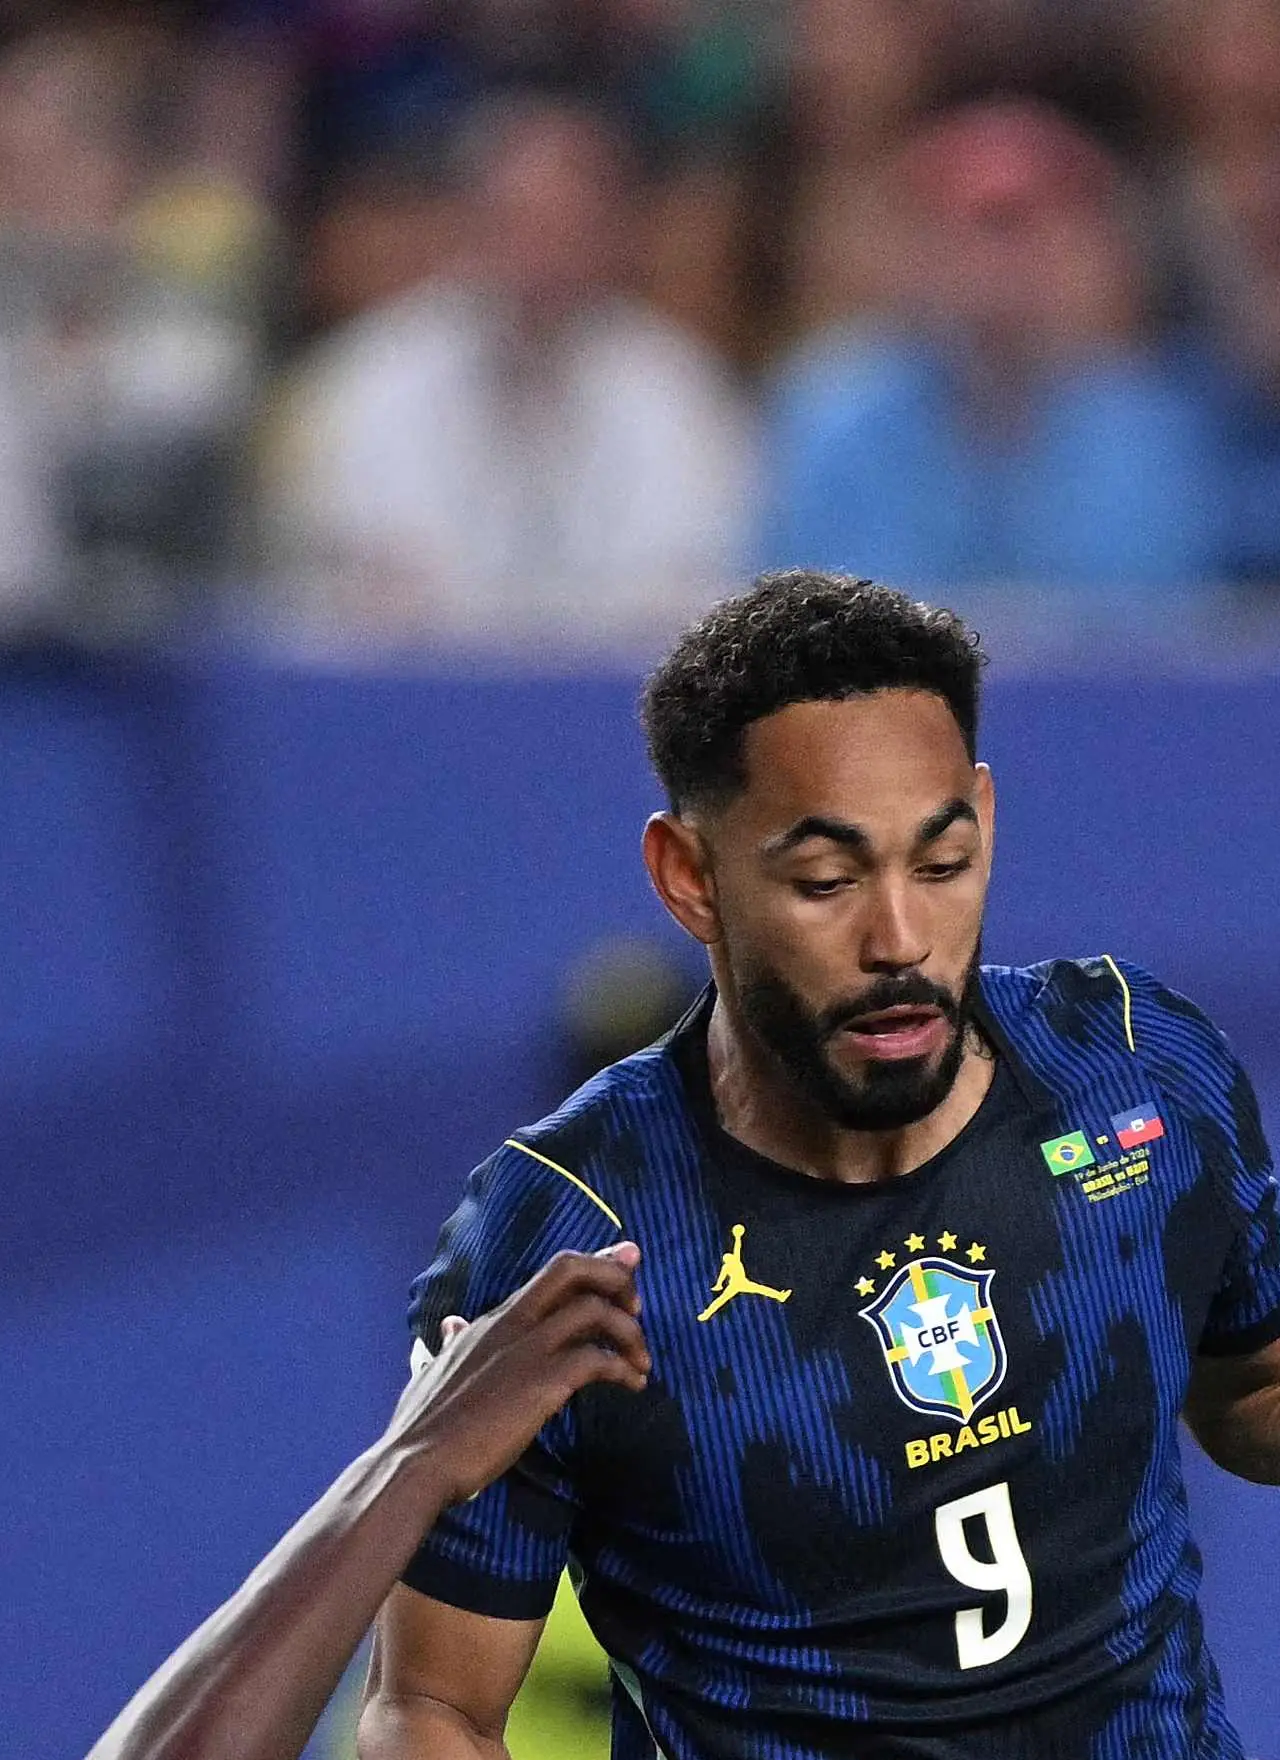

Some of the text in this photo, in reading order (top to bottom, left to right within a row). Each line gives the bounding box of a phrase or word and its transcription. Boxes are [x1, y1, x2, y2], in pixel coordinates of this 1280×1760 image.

[918, 1320, 961, 1348] CBF
[904, 1406, 1032, 1468] BRASIL
[935, 1482, 1033, 1670] 9
